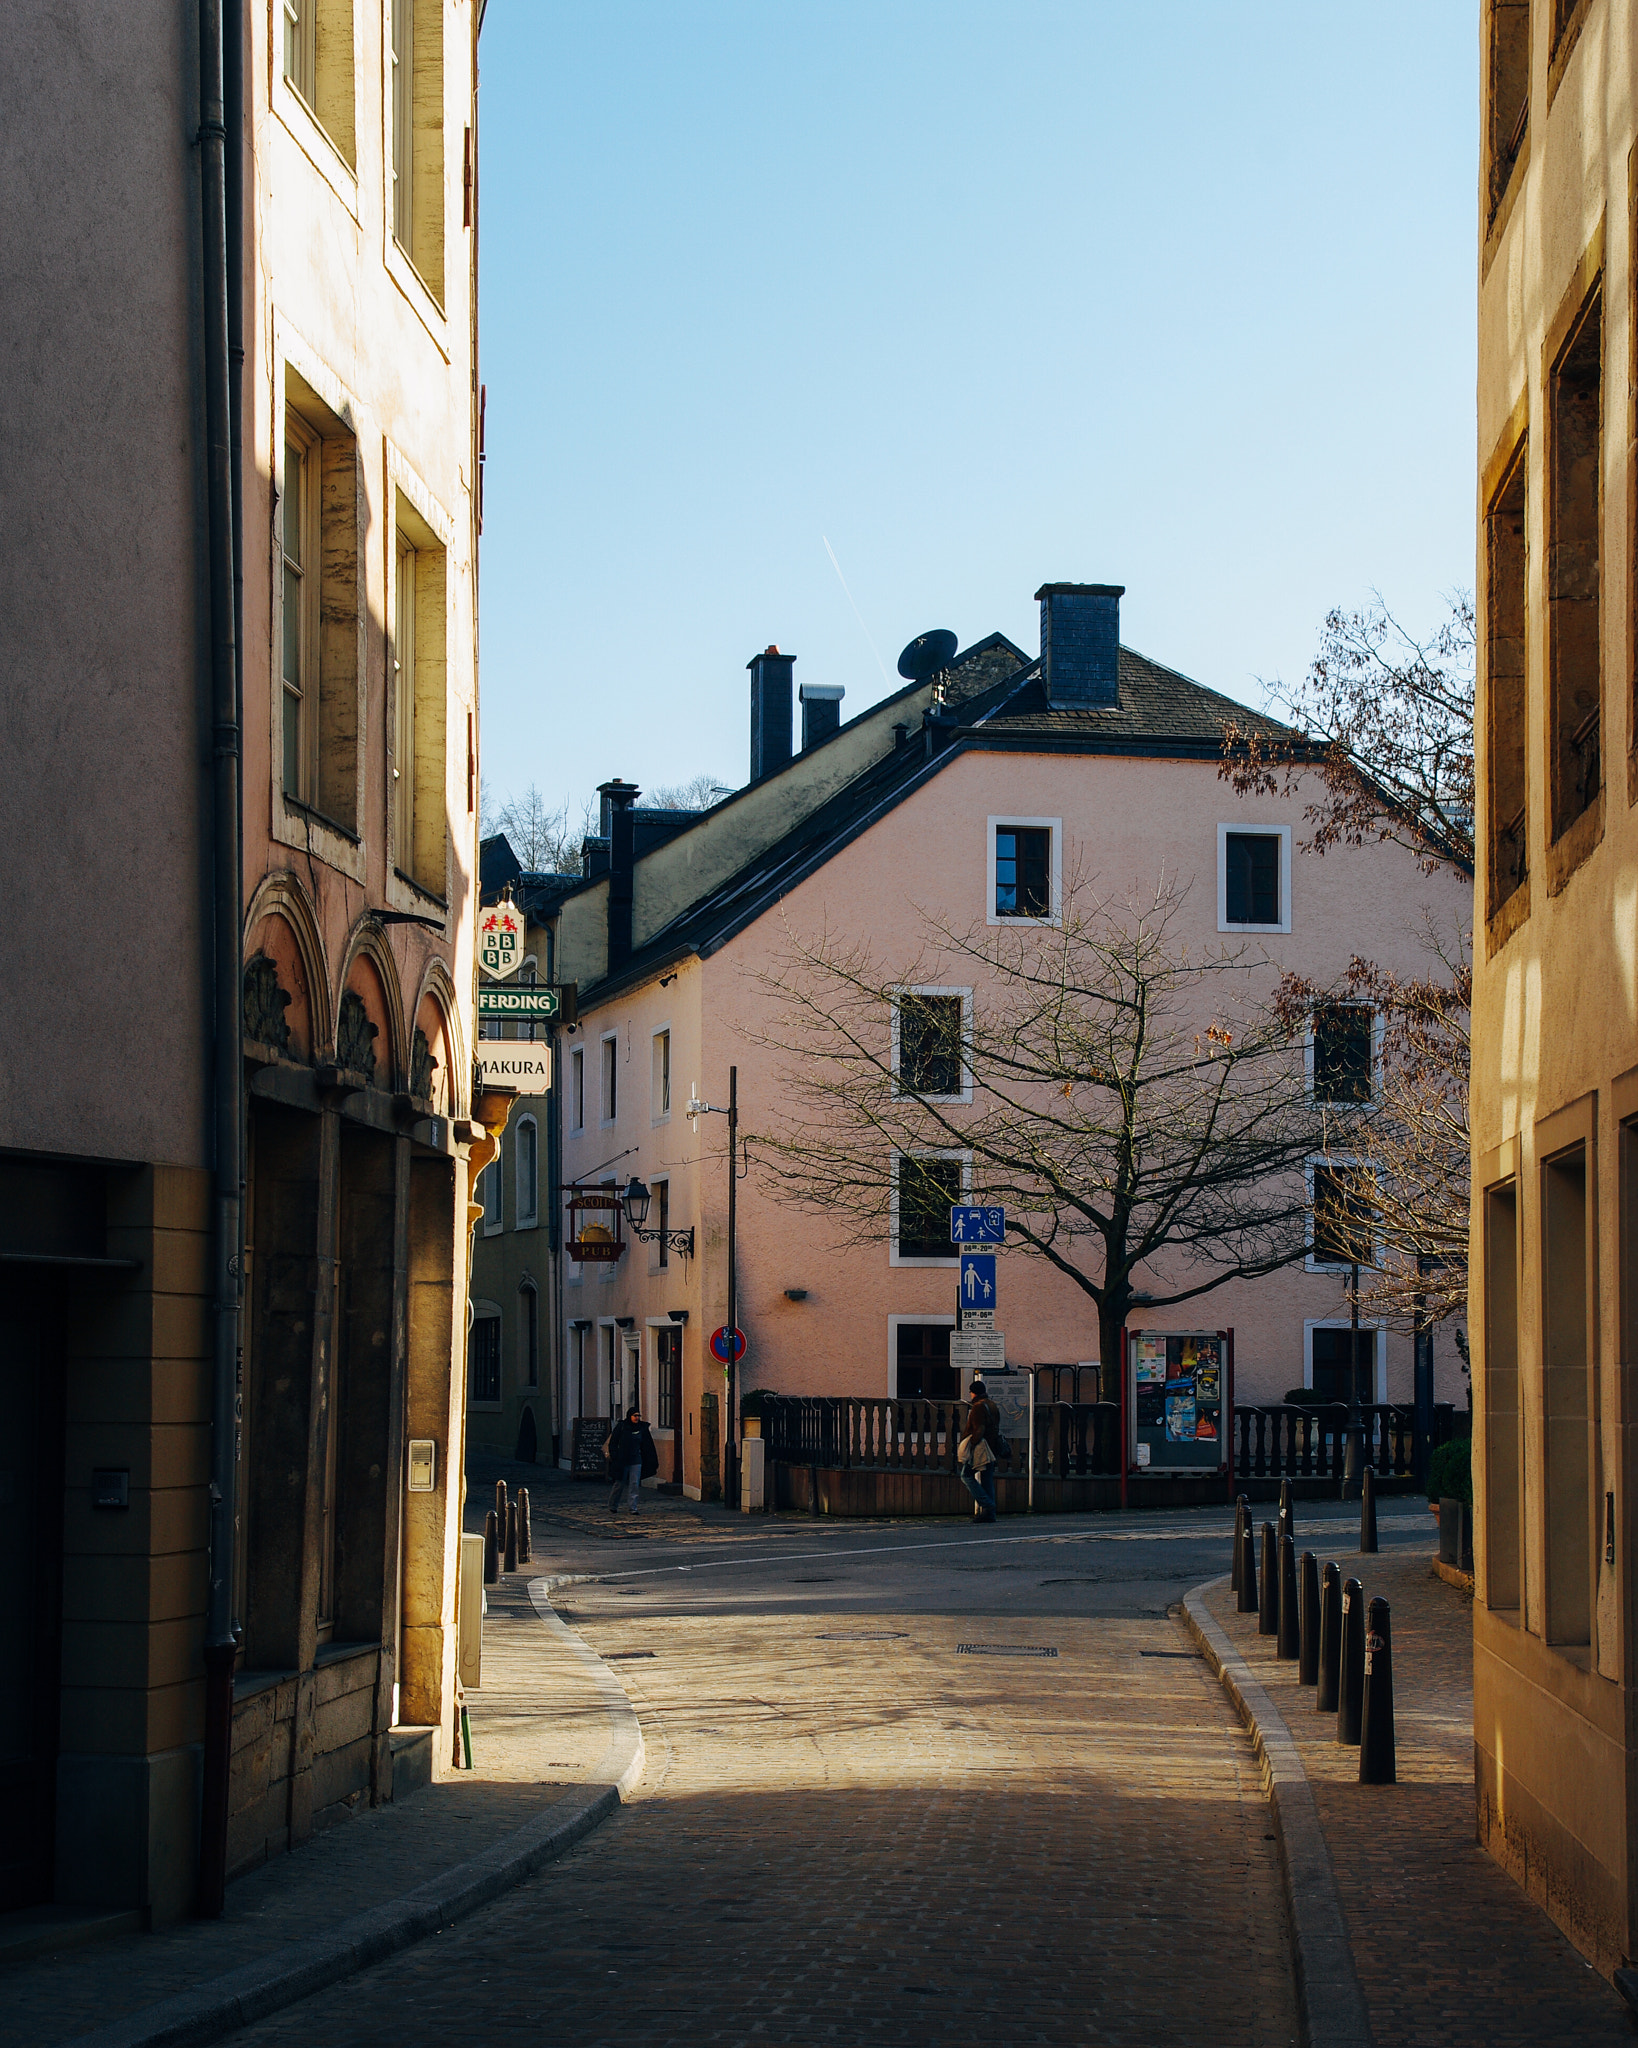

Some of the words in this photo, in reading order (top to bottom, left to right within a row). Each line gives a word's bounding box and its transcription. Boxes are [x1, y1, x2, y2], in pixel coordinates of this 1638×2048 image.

[487, 935, 497, 947] B
[502, 935, 512, 948] B
[487, 952, 497, 965] B
[502, 952, 512, 964] B
[479, 994, 551, 1010] FERDING
[582, 1246, 611, 1256] PUB
